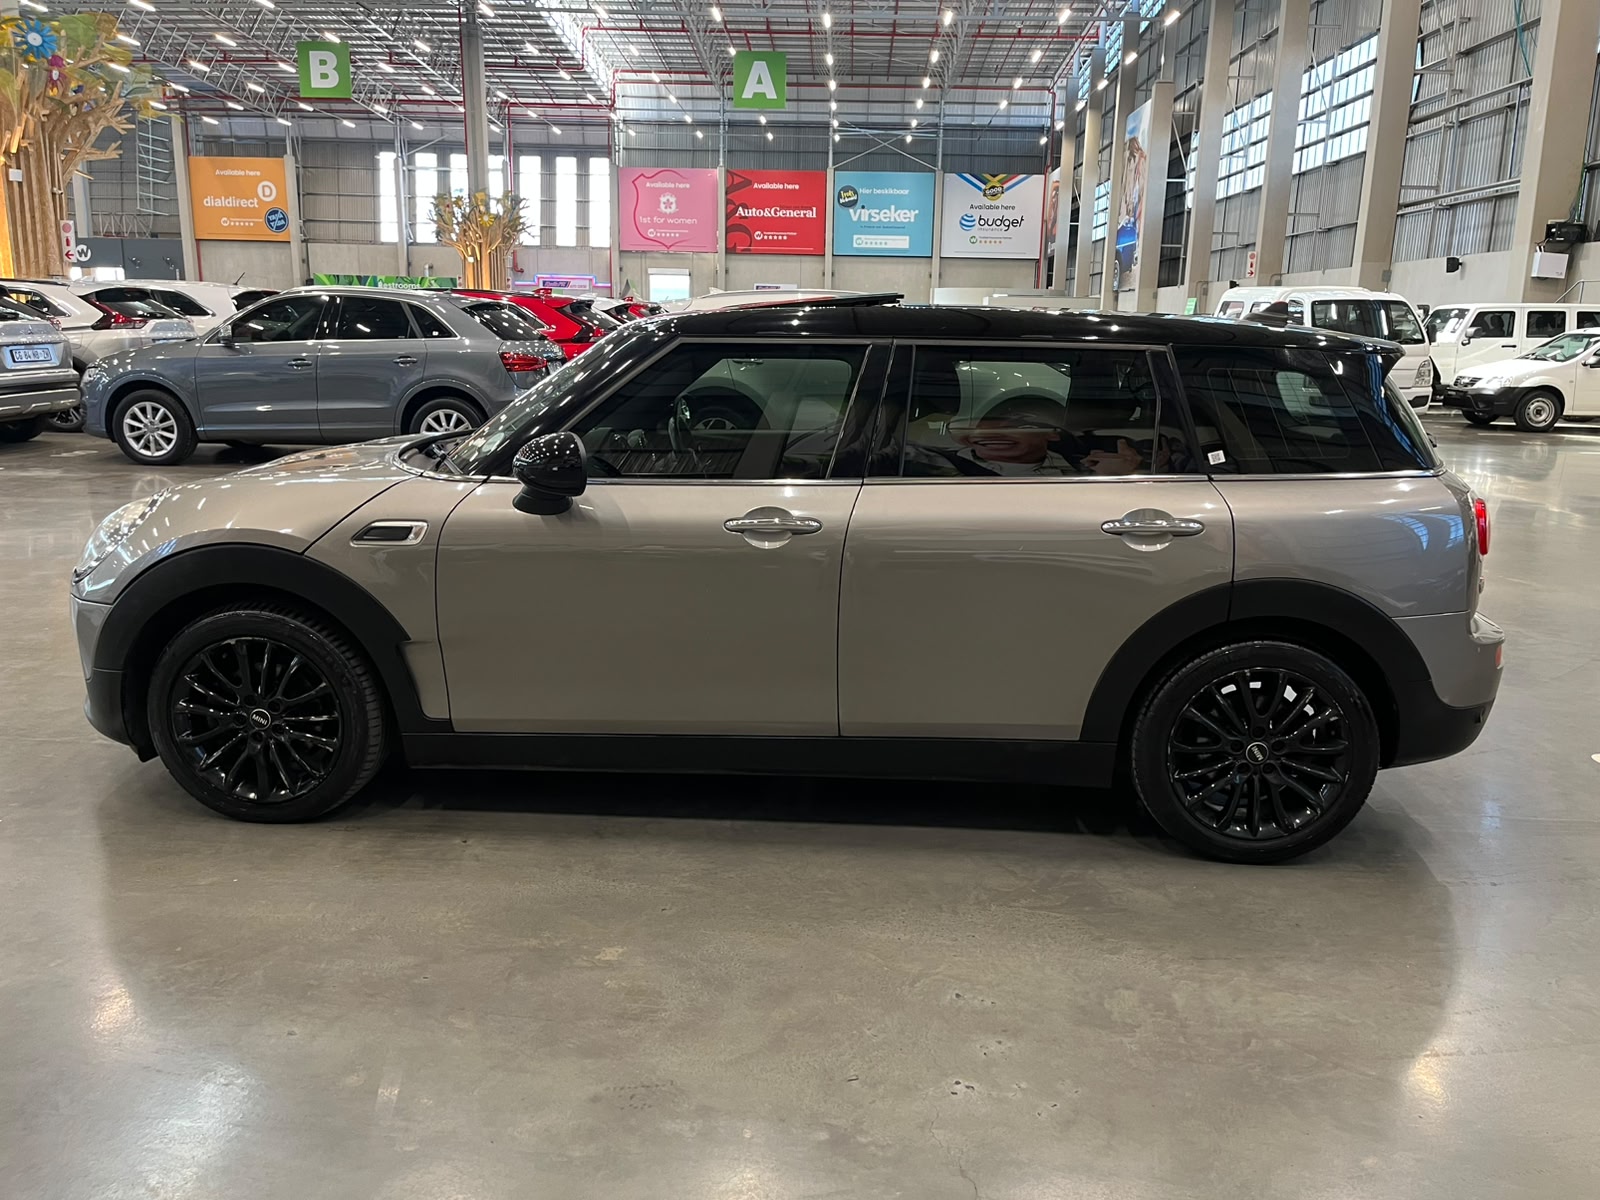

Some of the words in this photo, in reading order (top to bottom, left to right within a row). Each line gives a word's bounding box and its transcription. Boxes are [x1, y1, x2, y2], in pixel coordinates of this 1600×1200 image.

[309, 51, 339, 88] B
[741, 61, 777, 99] A
[874, 187, 910, 195] beskikbaar
[203, 196, 259, 208] dialdirect
[735, 206, 817, 218] Auto&General
[849, 205, 919, 223] virseker
[653, 216, 665, 224] for
[978, 214, 1025, 231] budget
[377, 281, 420, 289] Restrooms
[252, 714, 267, 725] MINI
[1251, 746, 1264, 760] MINI
